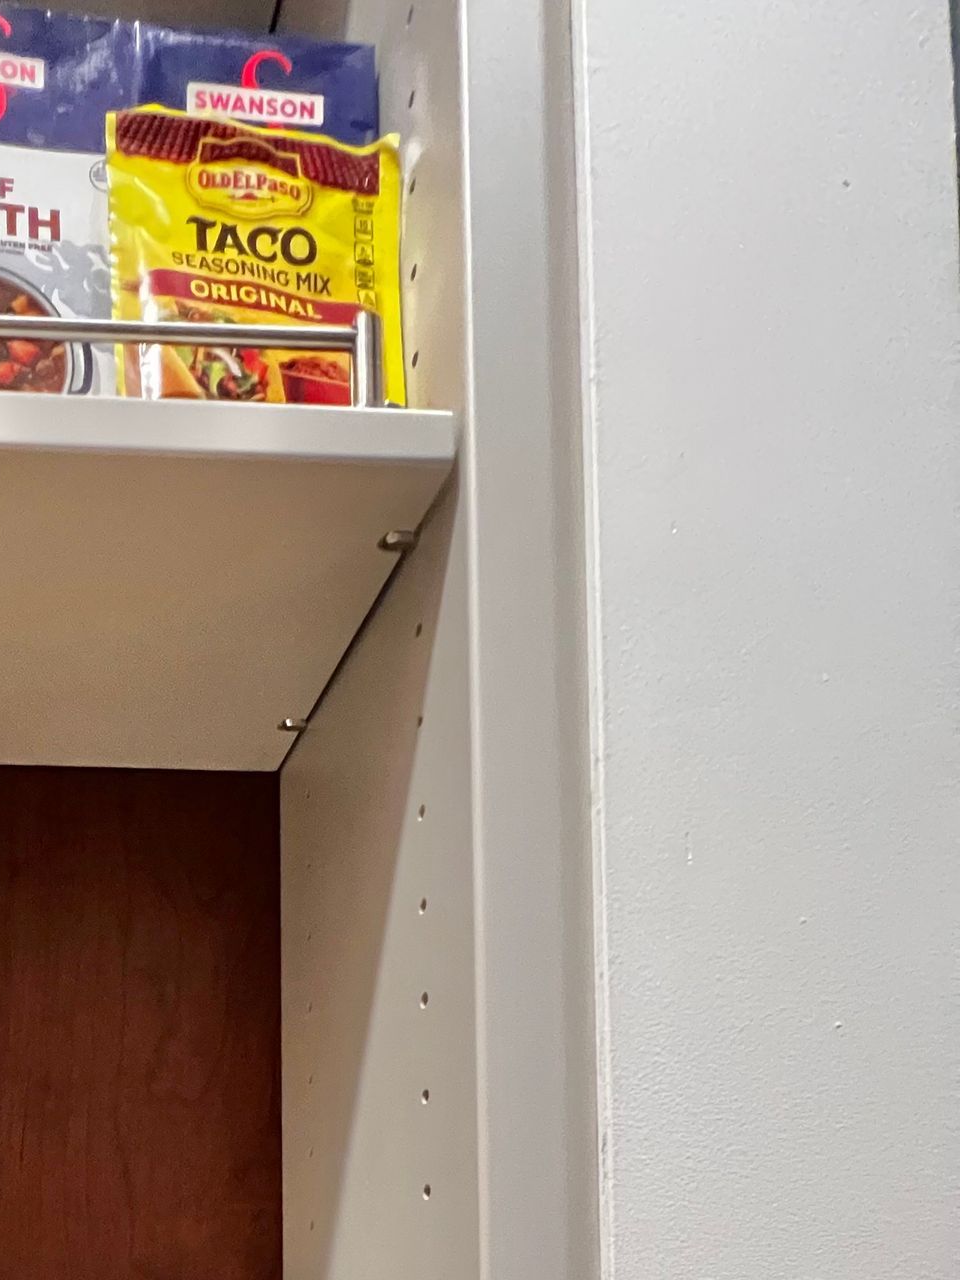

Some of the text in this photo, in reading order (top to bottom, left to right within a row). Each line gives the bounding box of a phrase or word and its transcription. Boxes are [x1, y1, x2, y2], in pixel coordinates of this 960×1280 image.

[195, 90, 315, 120] SWANSON
[198, 169, 231, 189] OLD
[186, 215, 318, 267] TACO
[171, 252, 290, 287] SEASONING
[296, 272, 332, 298] MIX
[190, 279, 322, 320] ORIGINAL
